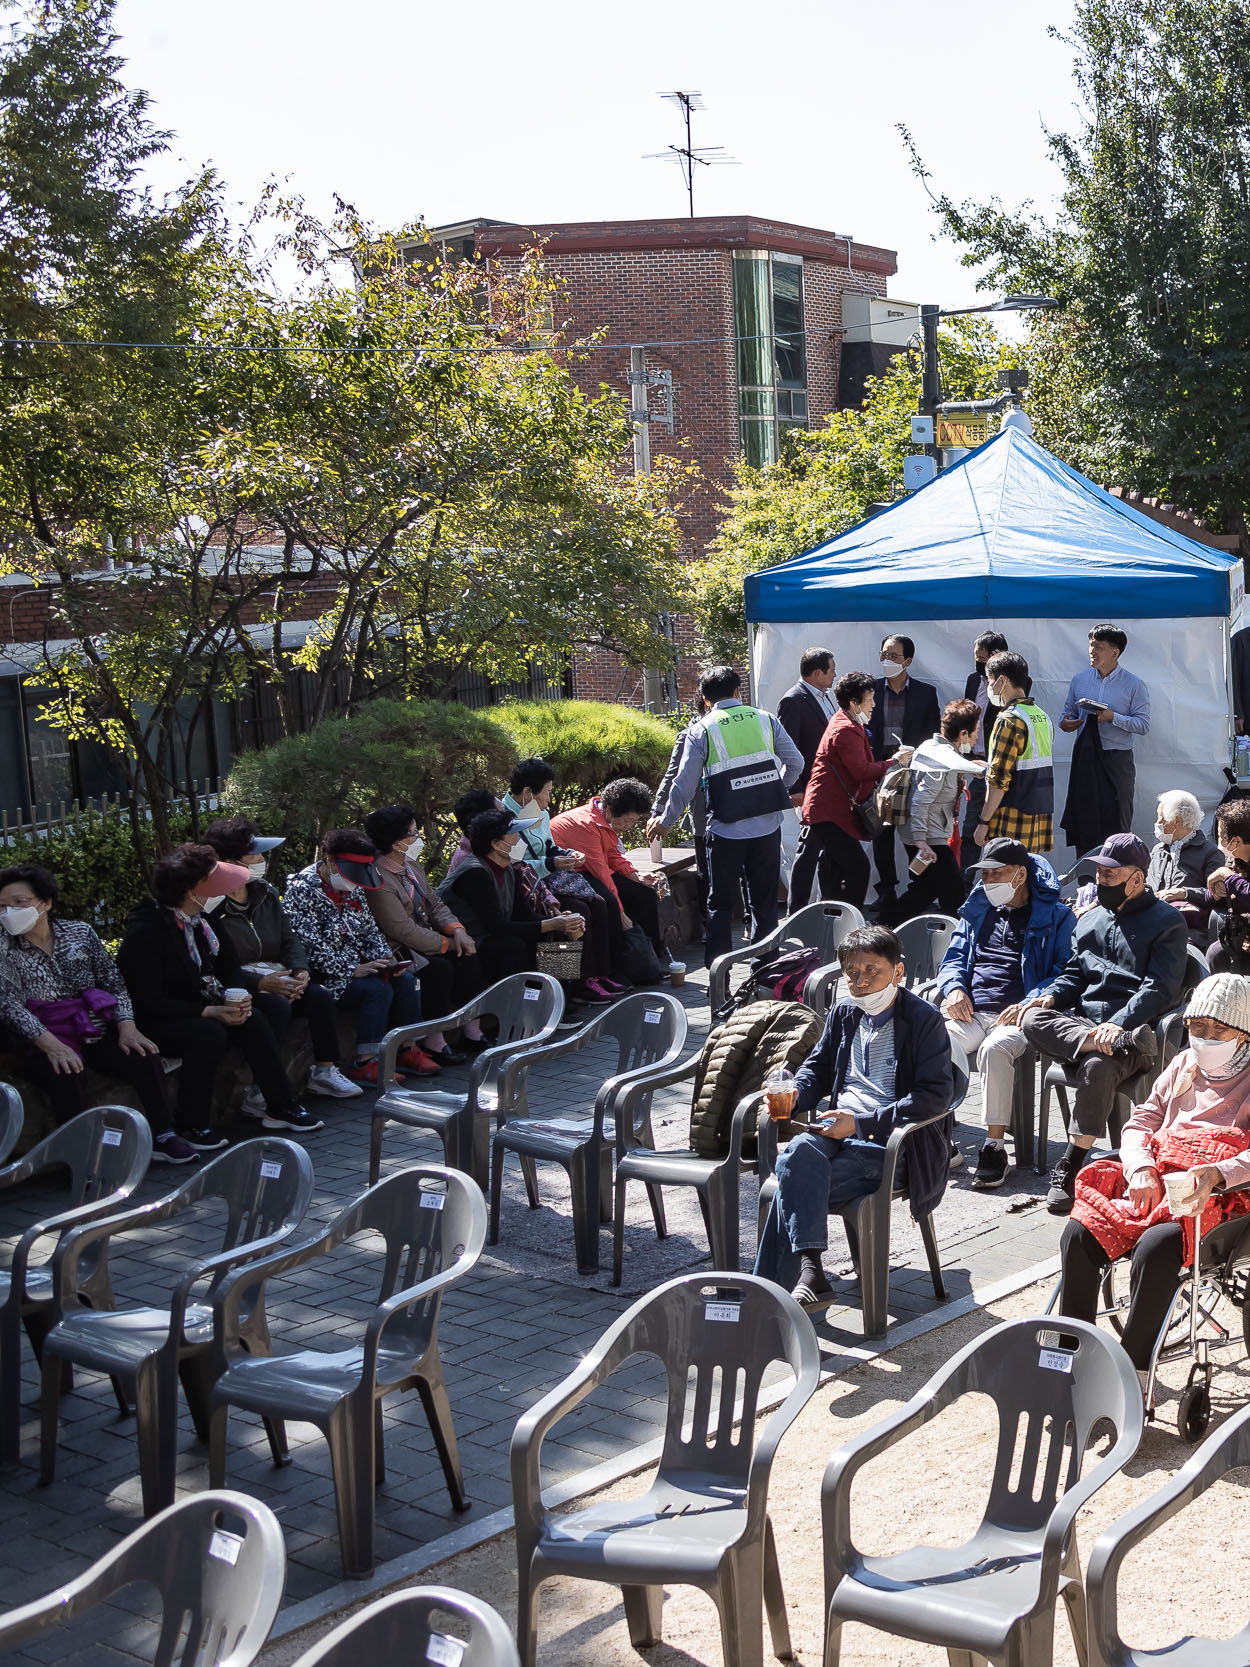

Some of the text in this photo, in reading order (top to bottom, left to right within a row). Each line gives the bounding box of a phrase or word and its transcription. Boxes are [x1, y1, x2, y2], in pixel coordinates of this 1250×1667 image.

[940, 423, 965, 441] CCTV
[718, 711, 757, 726] 광진구
[1029, 714, 1047, 723] 광진구
